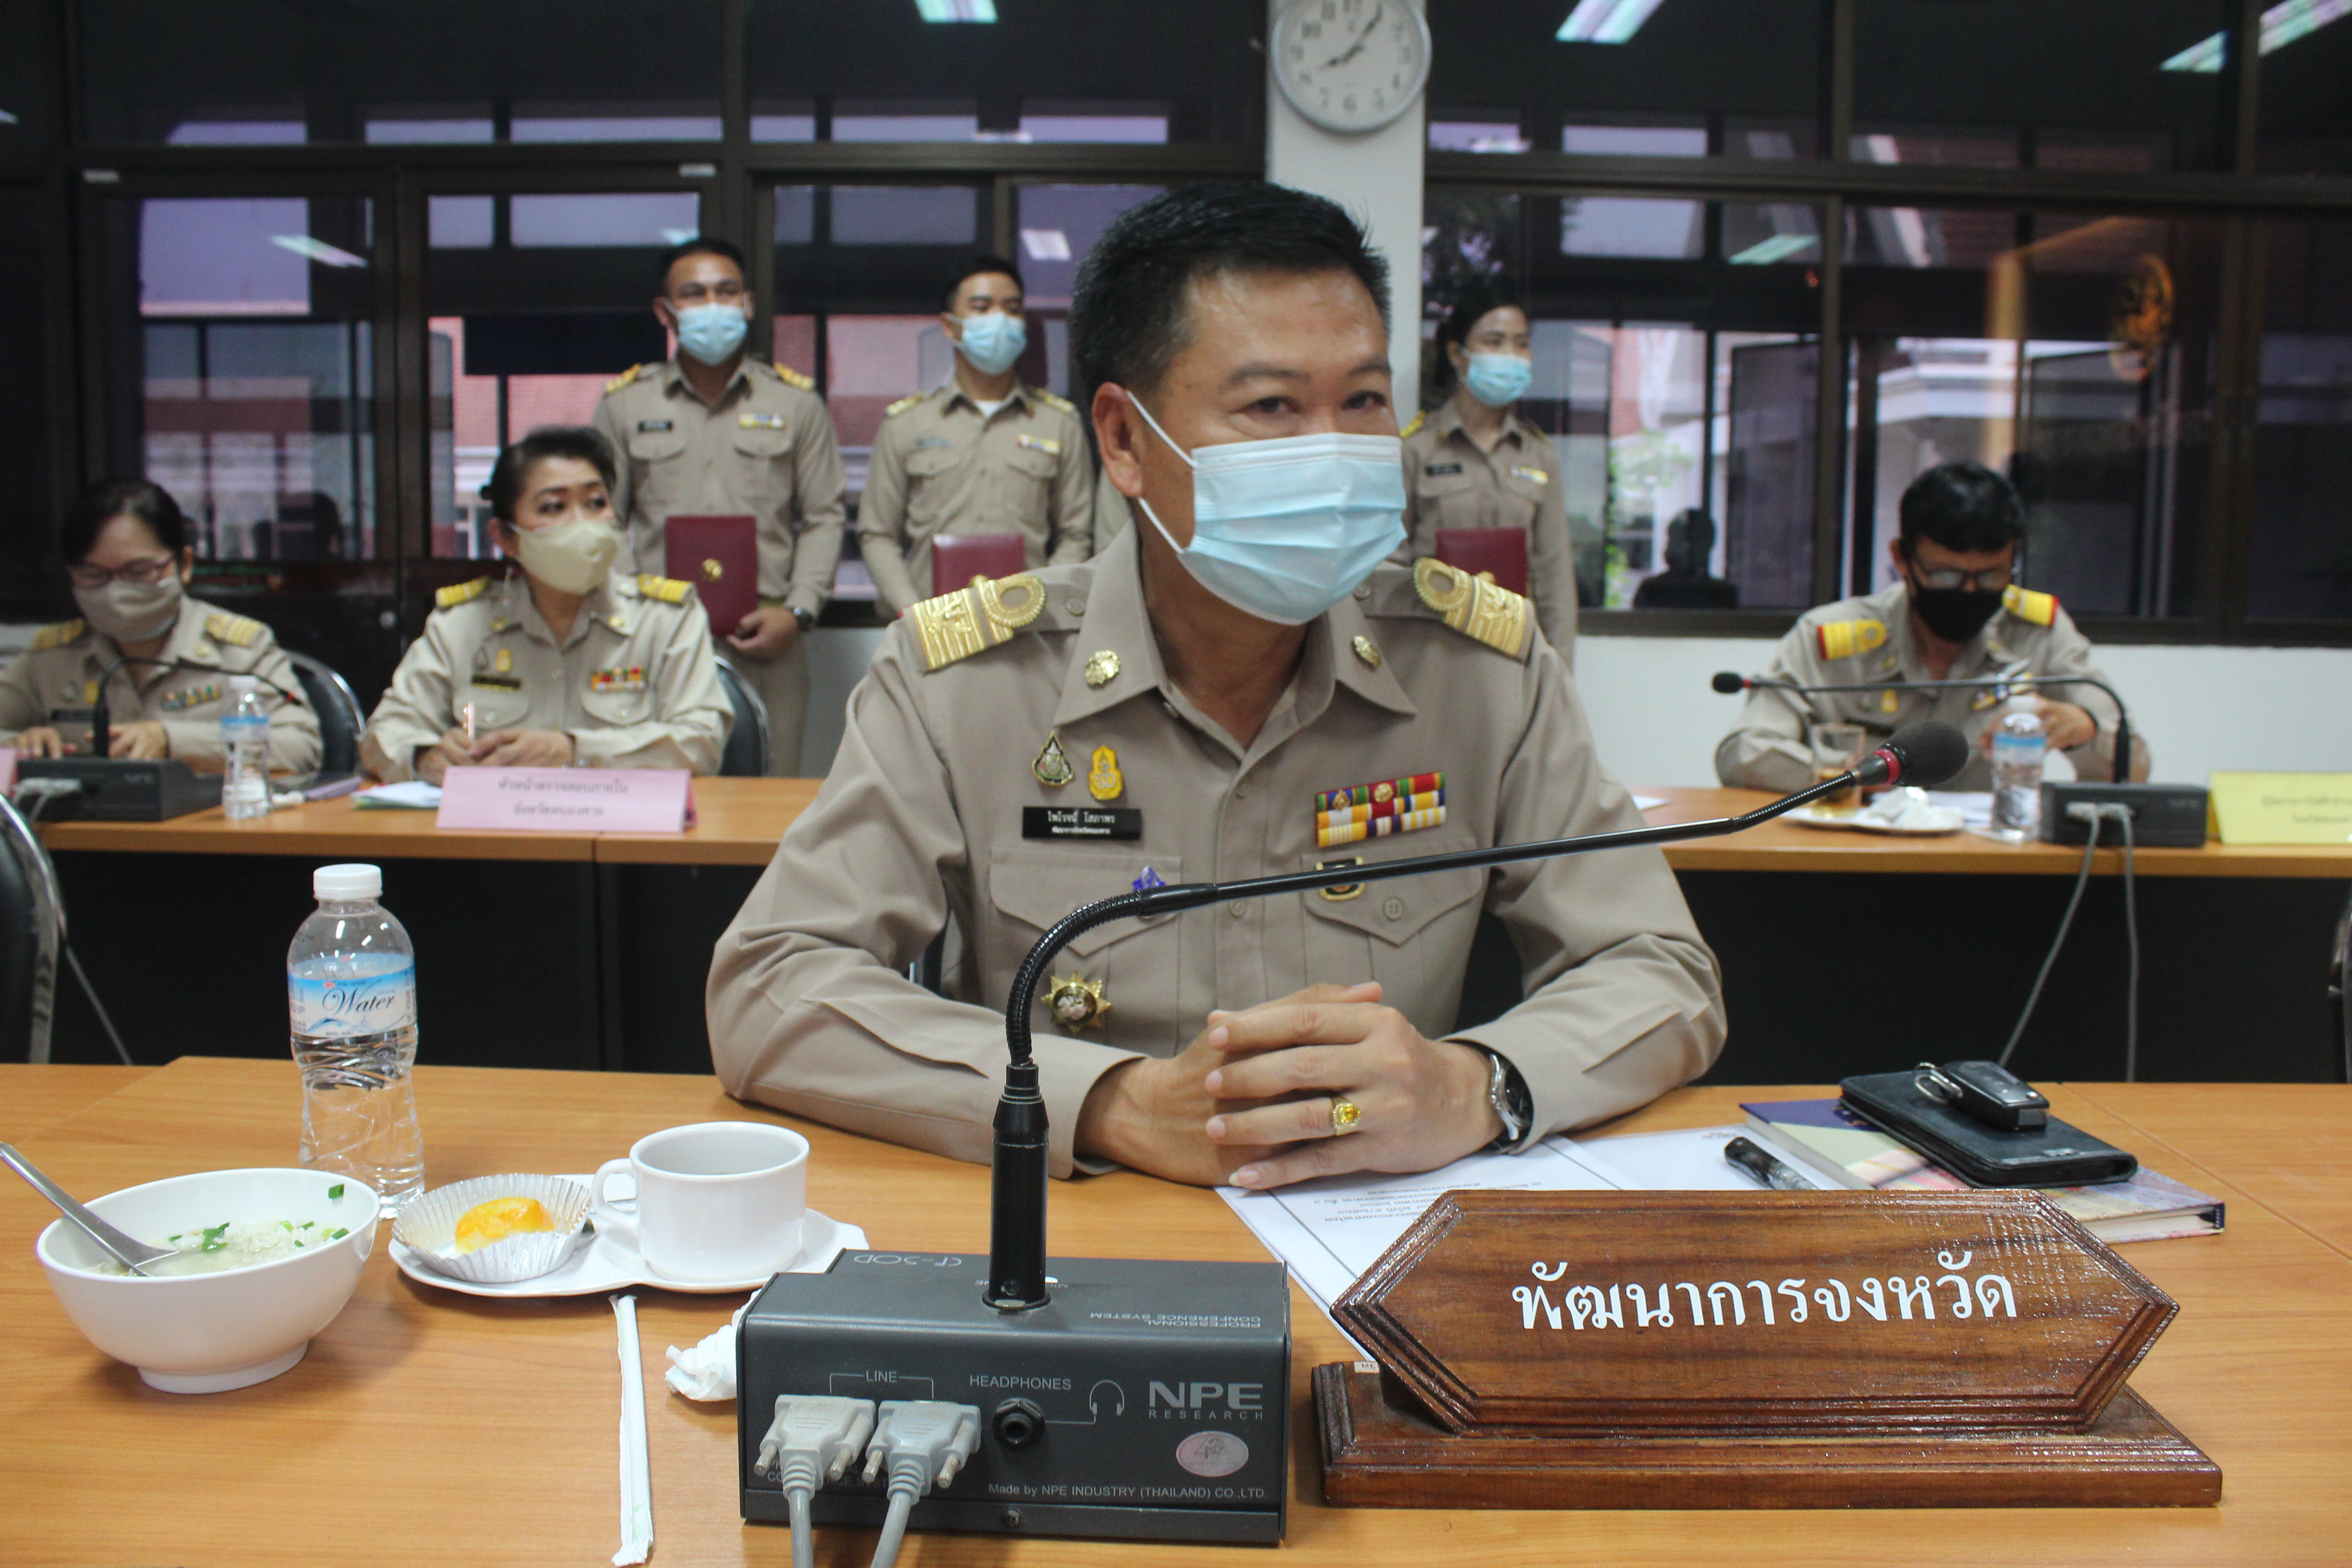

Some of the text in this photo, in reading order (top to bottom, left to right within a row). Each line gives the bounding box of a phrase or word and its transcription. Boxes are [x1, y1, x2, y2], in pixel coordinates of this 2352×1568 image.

[323, 980, 395, 1016] Water
[1090, 1312, 1261, 1323] CONFERENCE SYSTEM
[1147, 1319, 1261, 1328] PROFESSIONAL
[865, 1370, 898, 1383] LINE
[970, 1374, 1072, 1391] HEADPHONES
[1149, 1381, 1263, 1410] NPE
[1149, 1408, 1263, 1421] RESEARCH
[989, 1483, 1019, 1495] Made
[1024, 1485, 1038, 1497] by
[1042, 1485, 1067, 1496] NPE
[1072, 1485, 1136, 1497] INDUSTRY
[1141, 1486, 1211, 1498] (THAILAND)
